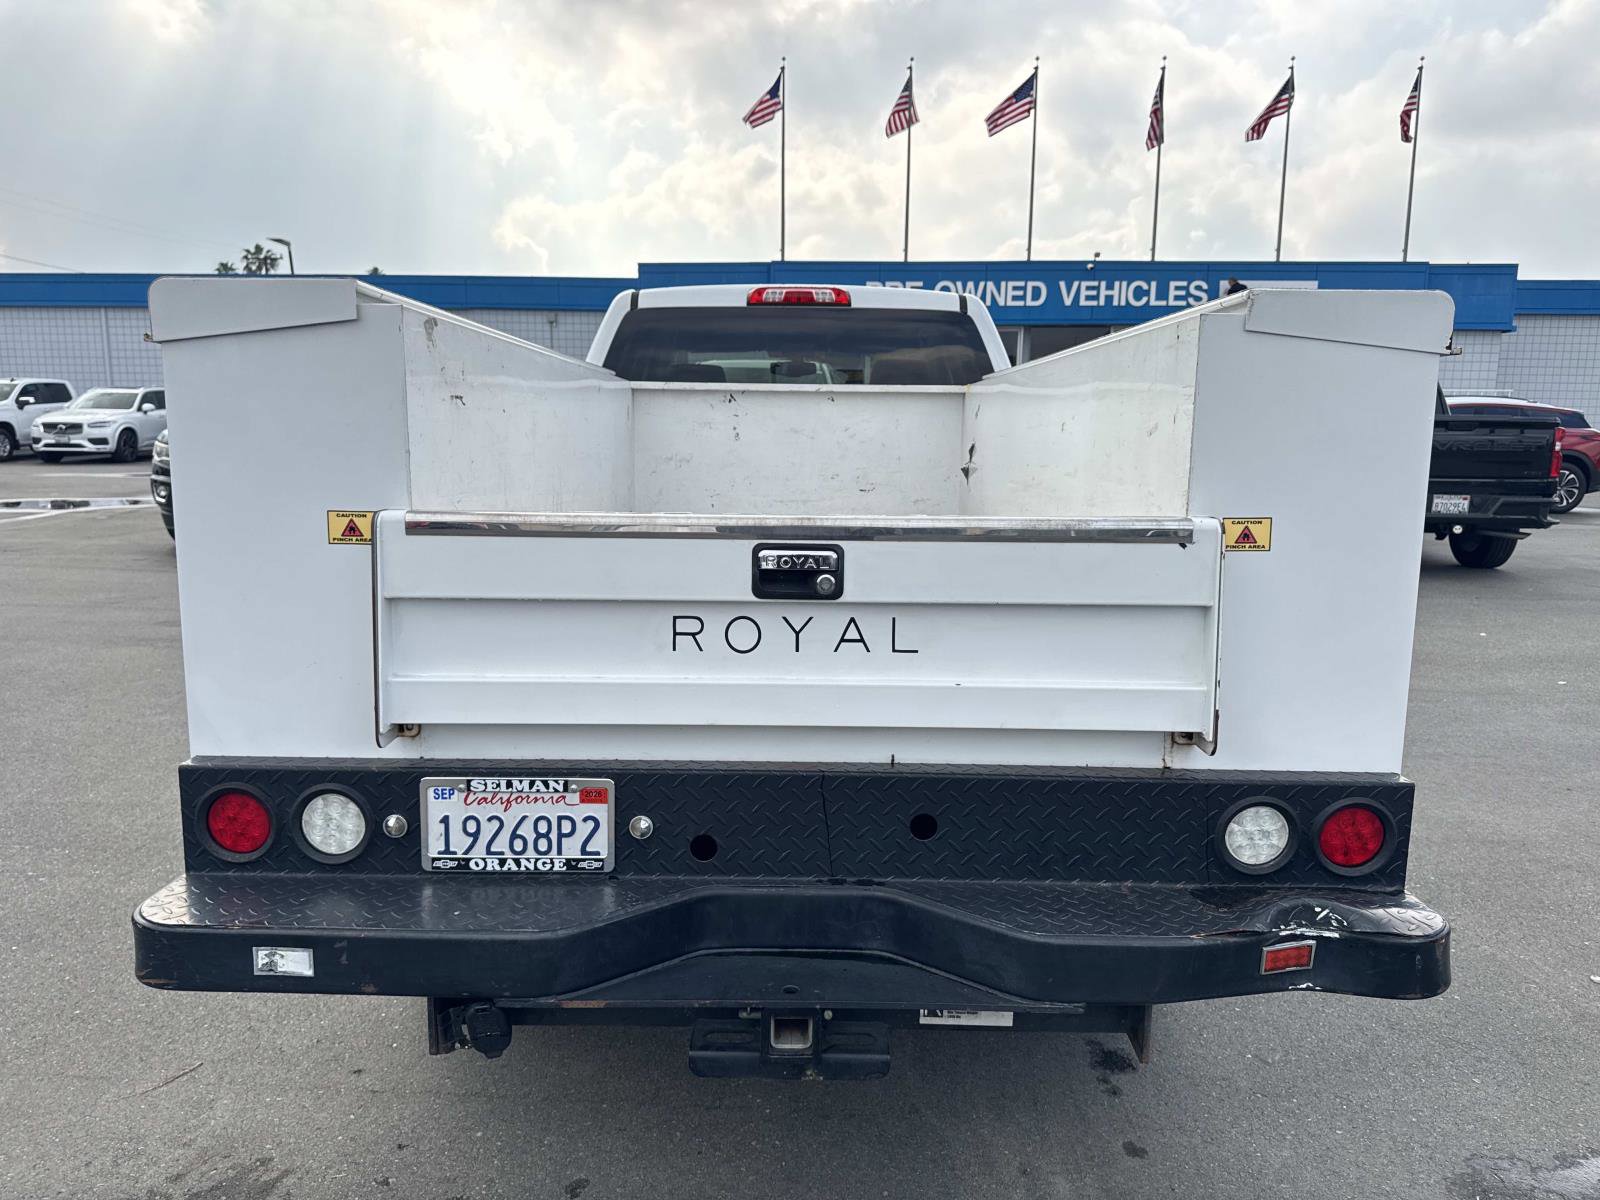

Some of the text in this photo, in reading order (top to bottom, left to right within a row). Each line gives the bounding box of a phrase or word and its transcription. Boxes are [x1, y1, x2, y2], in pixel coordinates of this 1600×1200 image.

[1058, 280, 1208, 307] VEHICLES
[764, 555, 830, 569] ROYAL
[672, 615, 919, 654] ROYAL
[469, 779, 565, 792] SELMAN
[433, 787, 456, 800] SEP
[584, 790, 603, 798] 2026
[463, 791, 580, 812] California
[437, 814, 601, 856] 19268P2
[468, 858, 567, 871] ORANGE
